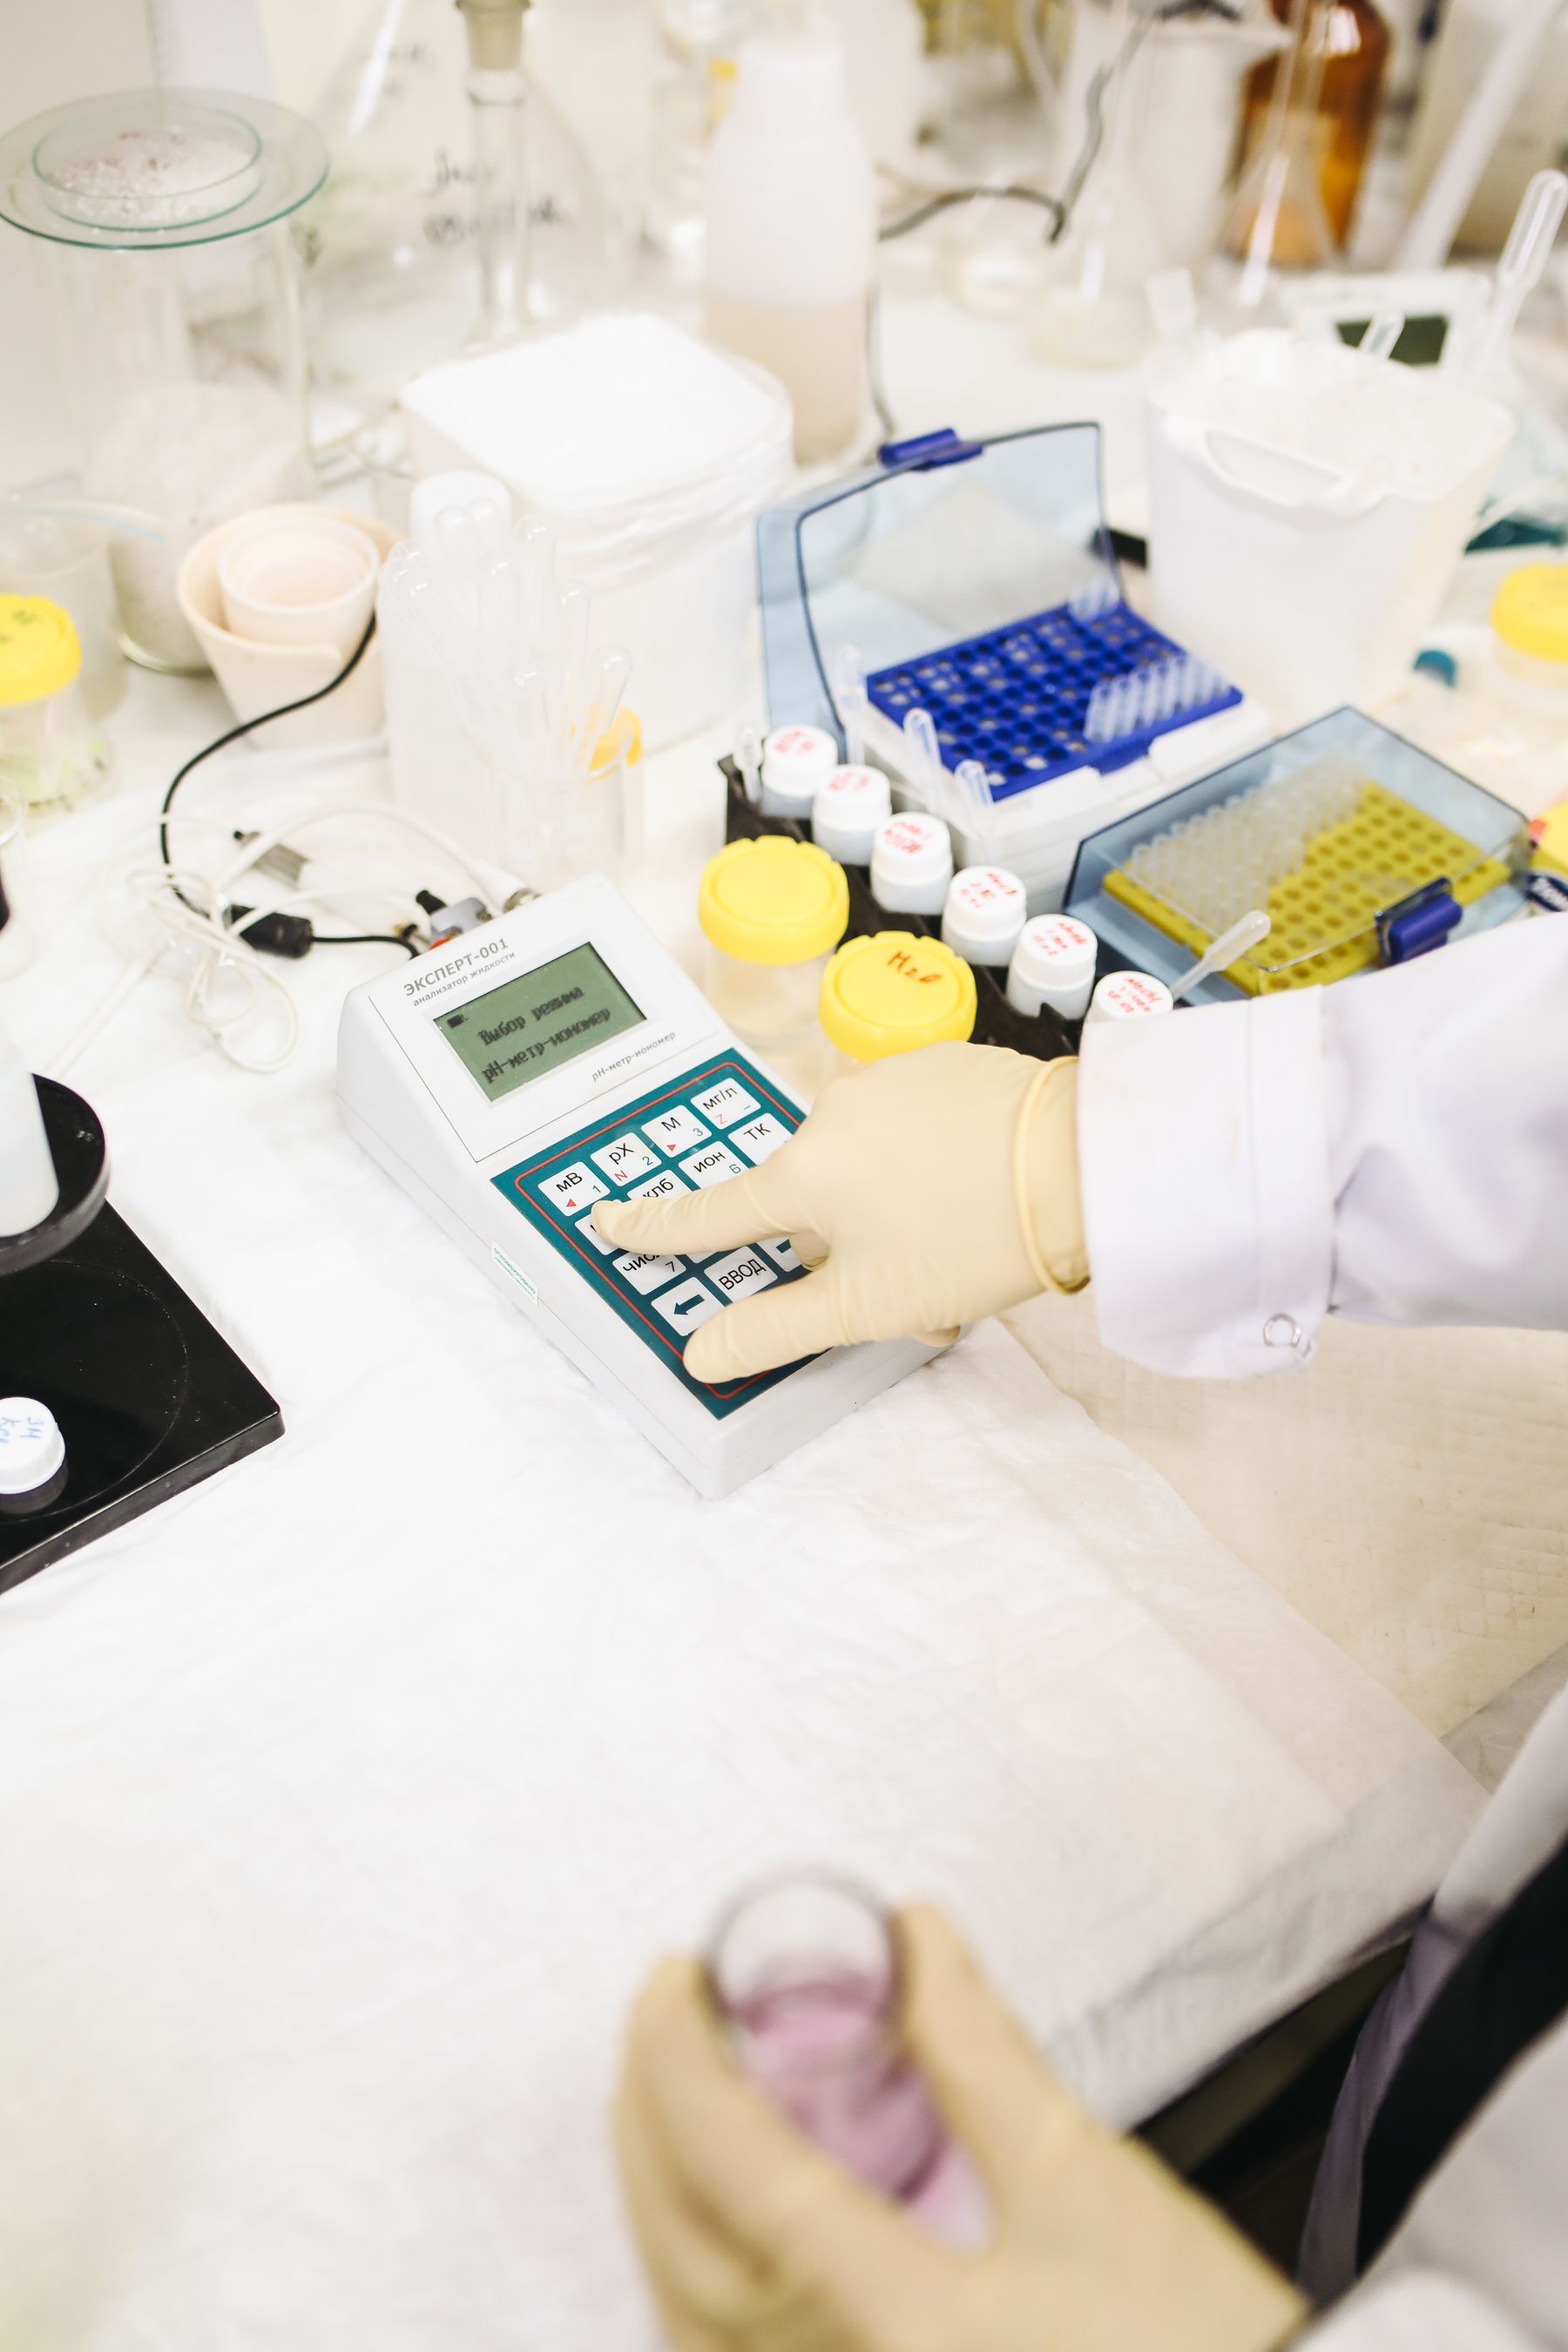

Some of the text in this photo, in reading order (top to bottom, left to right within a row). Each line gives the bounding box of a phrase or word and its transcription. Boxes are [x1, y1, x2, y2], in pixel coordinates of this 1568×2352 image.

[403, 937, 509, 997] ЭКСПЕРТ-001
[412, 950, 516, 1007] анализатор жидкости
[476, 984, 585, 1046] Выбор режима
[591, 1031, 677, 1083] pH-метр-иономер
[702, 1086, 738, 1111] мг/л
[660, 1117, 681, 1132] М
[715, 1113, 728, 1125] Z
[693, 1127, 704, 1137] 3
[743, 1123, 771, 1140] ТК
[608, 1142, 634, 1165] pX
[642, 1155, 653, 1166] 2
[693, 1152, 726, 1173] ион
[614, 1169, 628, 1181] N
[729, 1164, 742, 1174] 6
[556, 1172, 583, 1193] мВ
[592, 1185, 601, 1193] 1
[622, 1254, 660, 1272] чис
[665, 1260, 676, 1273] 7
[718, 1258, 767, 1290] ВВОД
